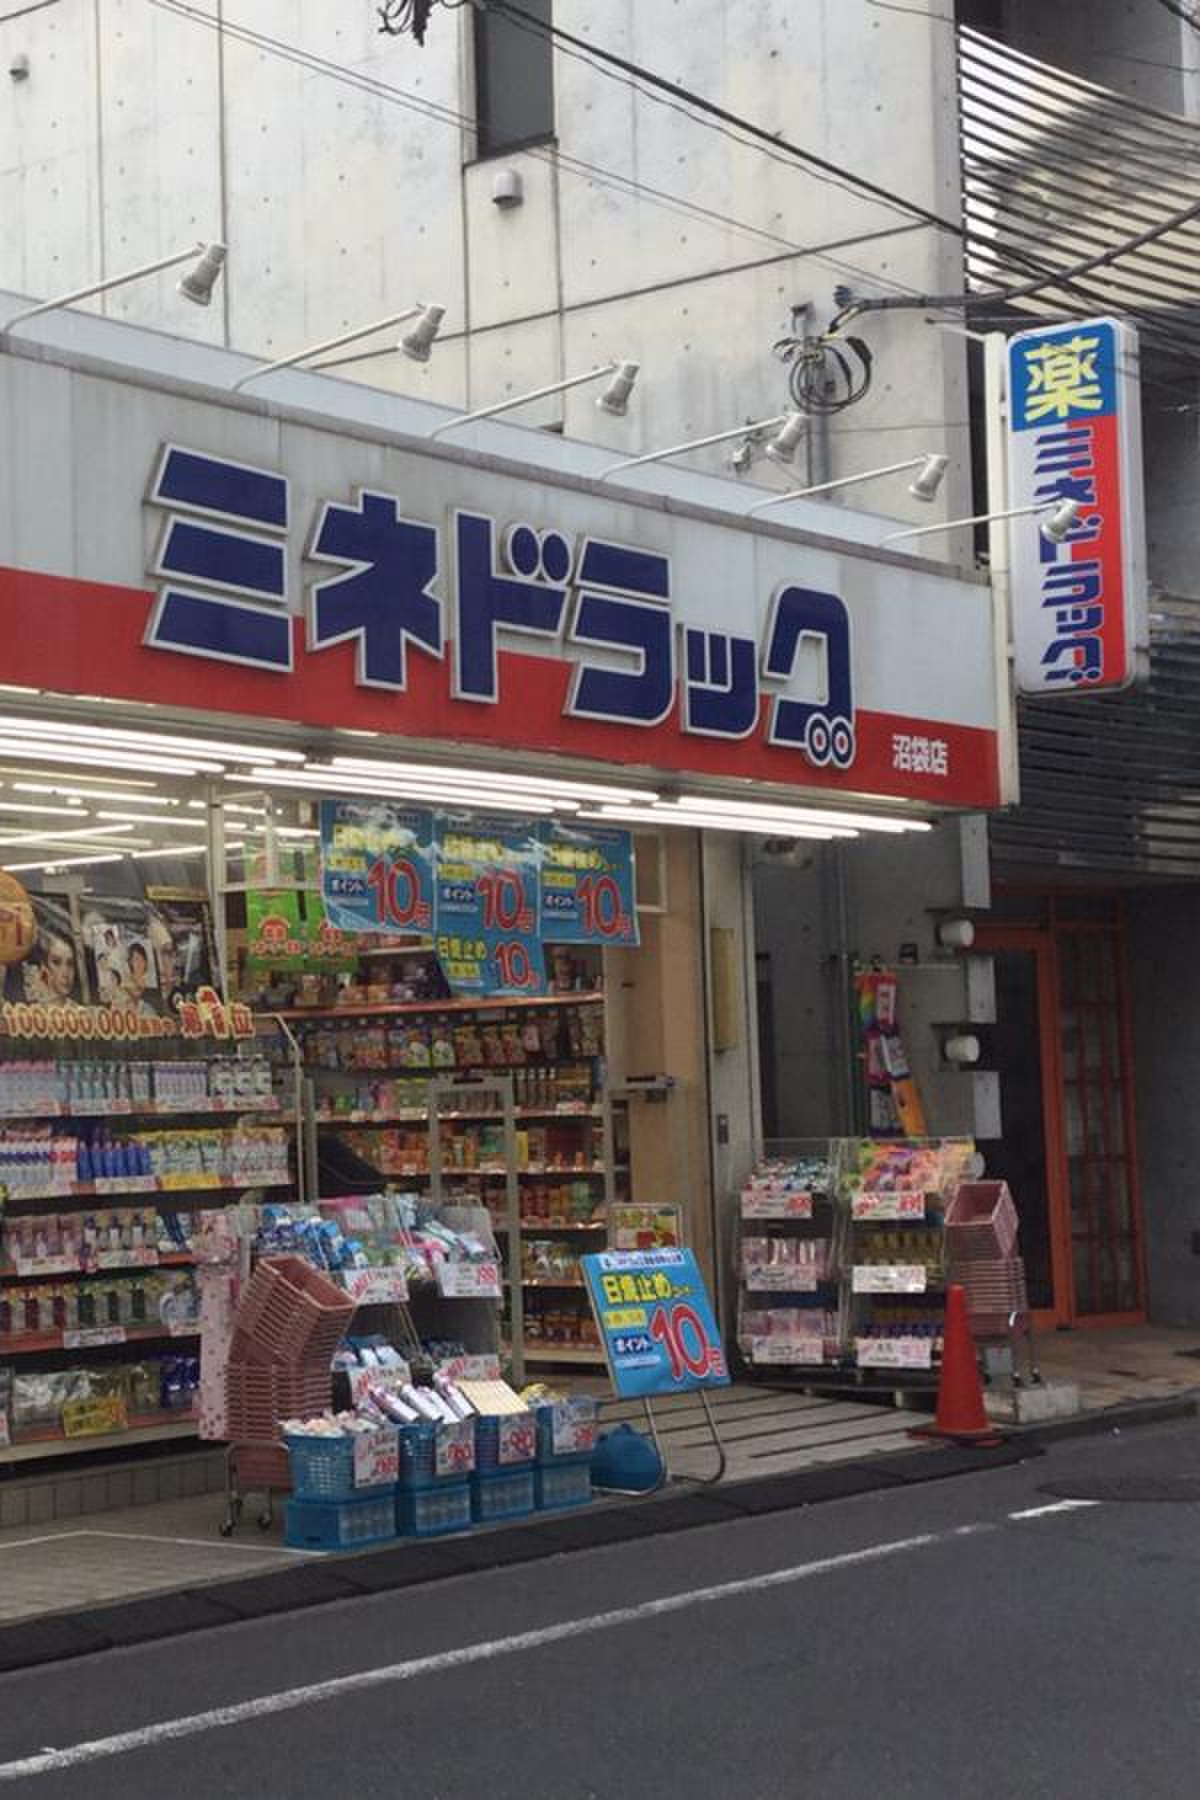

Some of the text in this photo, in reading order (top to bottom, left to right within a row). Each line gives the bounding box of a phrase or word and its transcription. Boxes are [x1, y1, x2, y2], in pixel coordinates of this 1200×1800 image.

[1023, 335, 1104, 423] 薬
[143, 442, 857, 769] ミネドラッグ
[891, 733, 949, 777] 沼袋店
